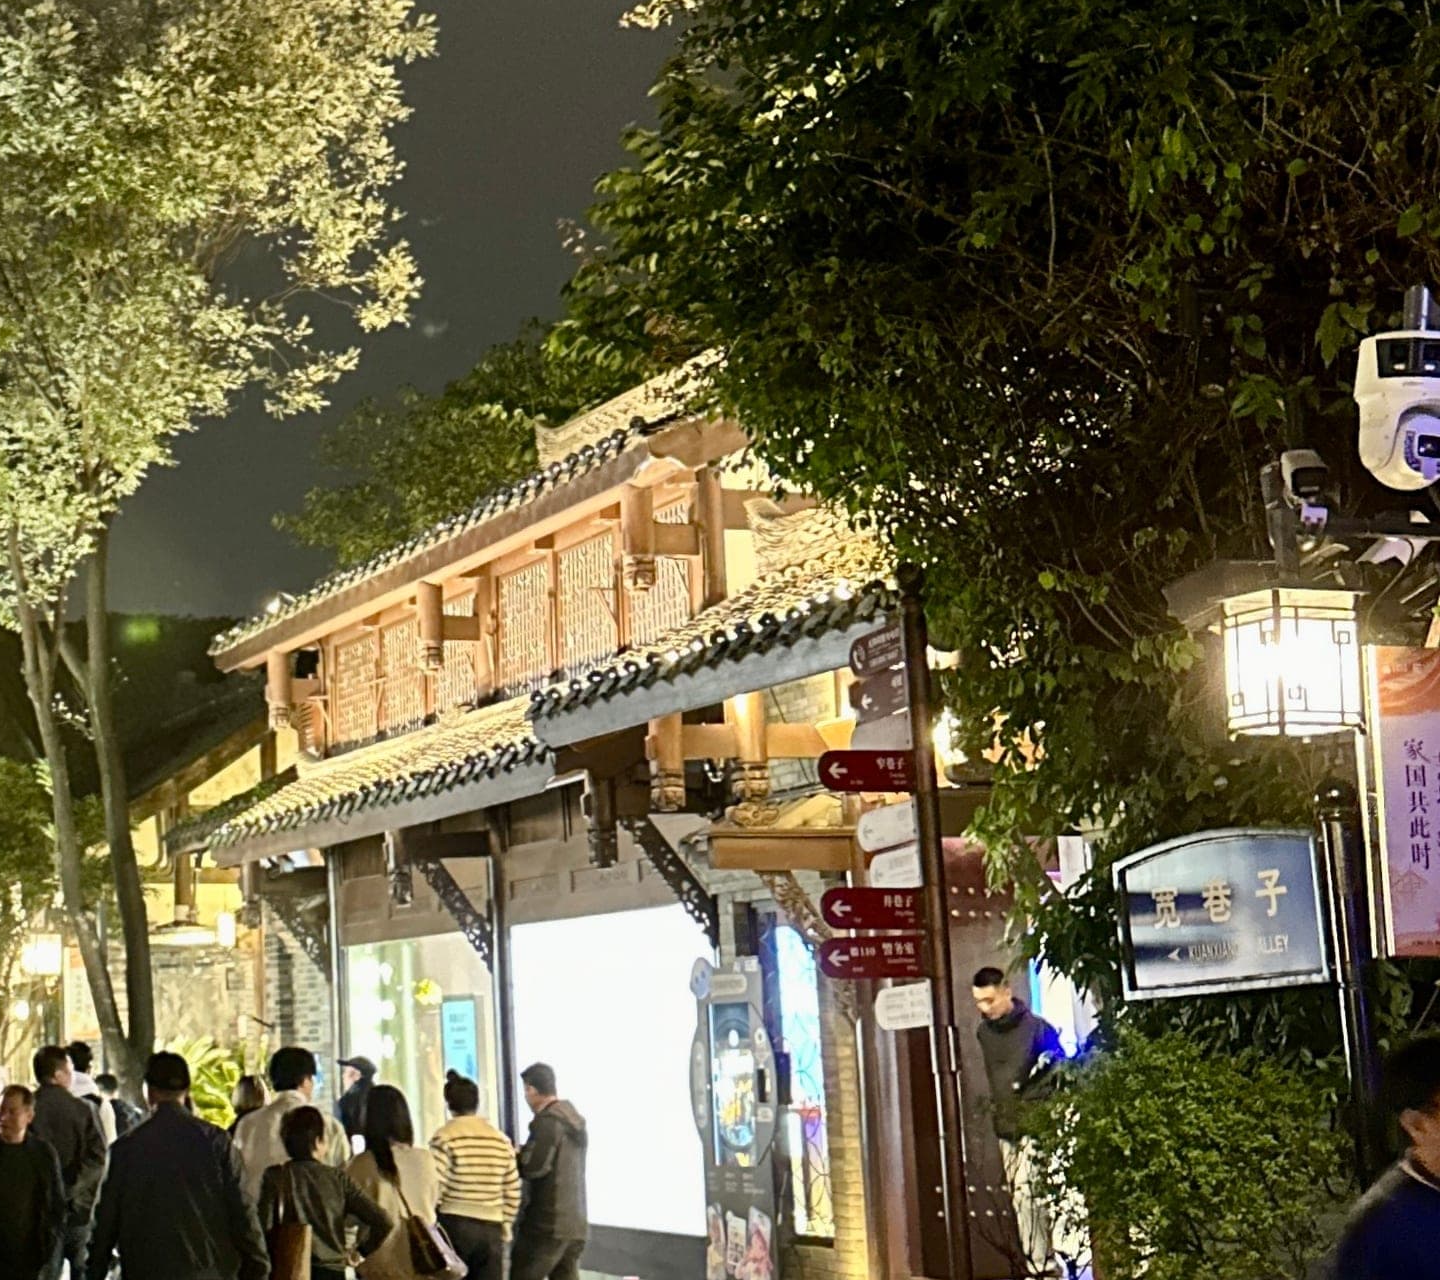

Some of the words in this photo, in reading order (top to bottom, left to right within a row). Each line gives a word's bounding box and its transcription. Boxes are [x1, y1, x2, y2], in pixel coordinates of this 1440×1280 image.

[1404, 738, 1432, 870] 家国共此时
[1152, 869, 1288, 929] 宽巷子
